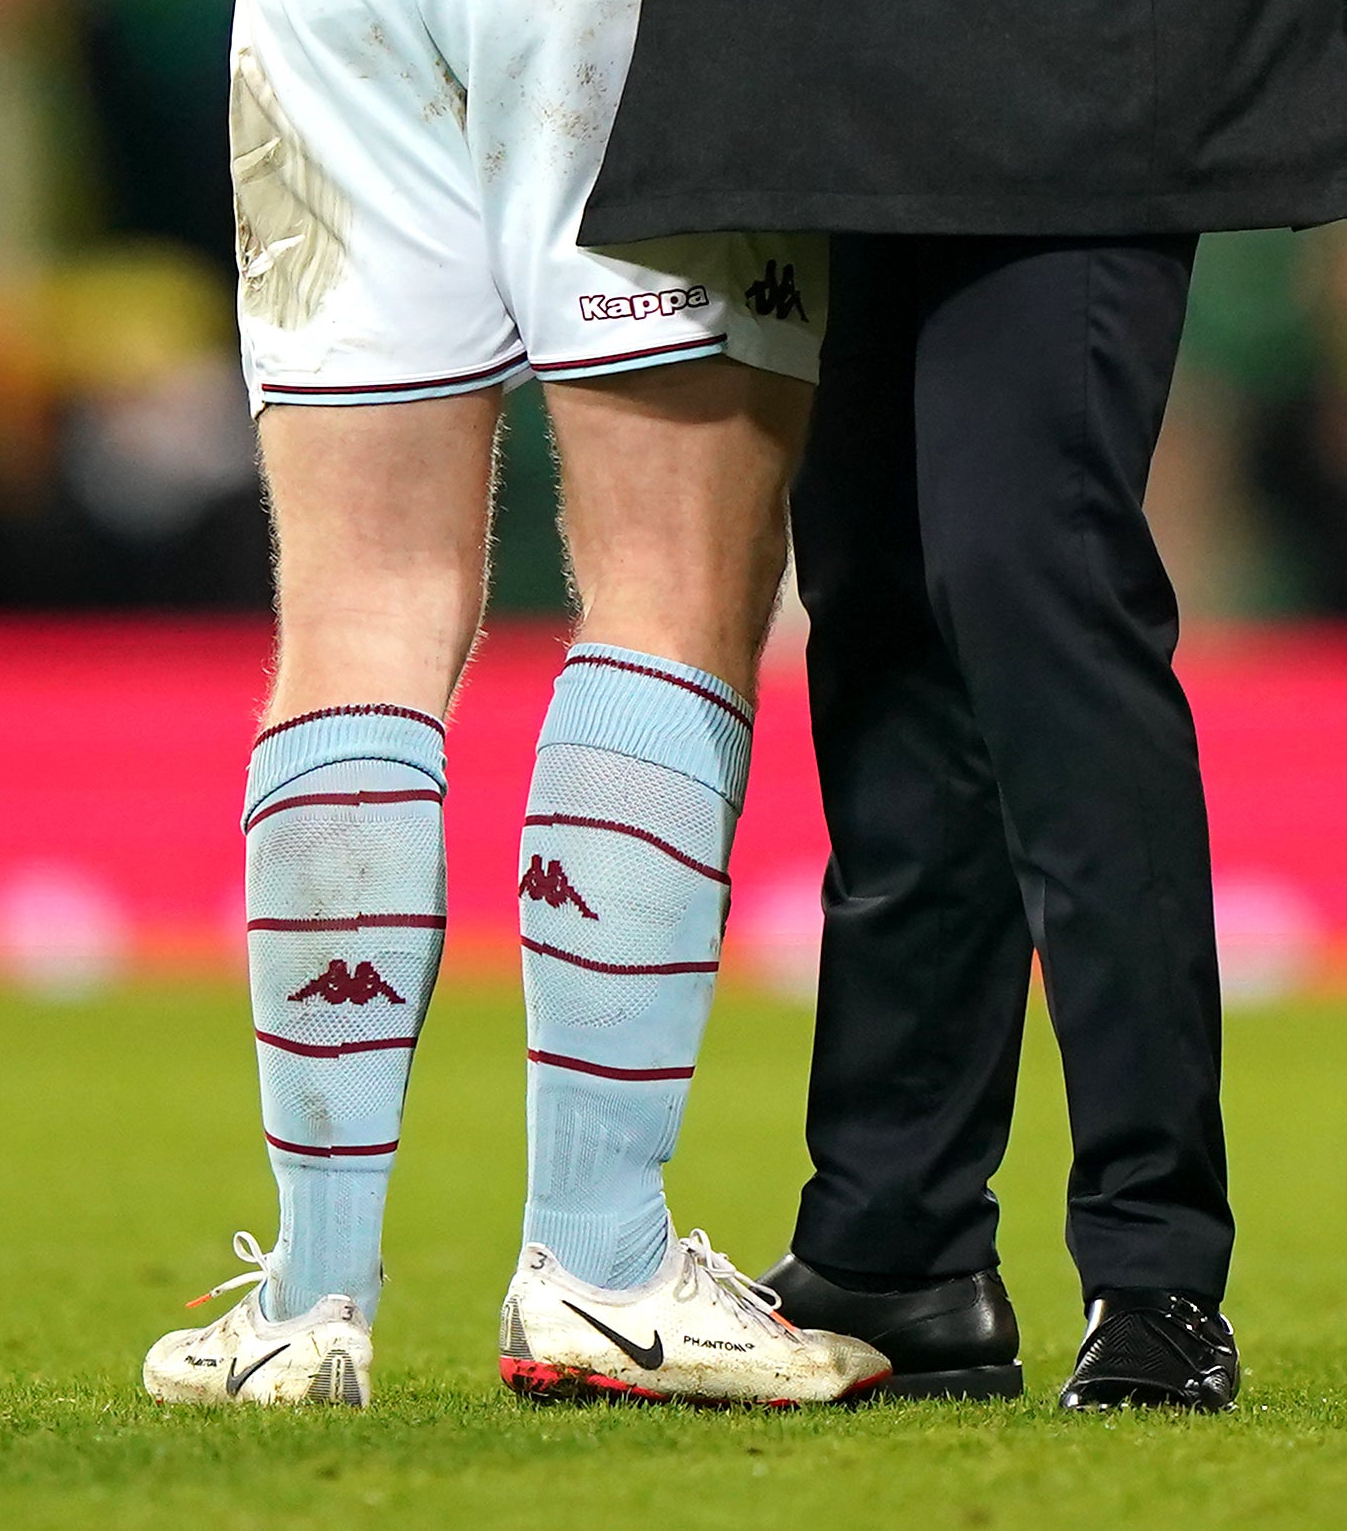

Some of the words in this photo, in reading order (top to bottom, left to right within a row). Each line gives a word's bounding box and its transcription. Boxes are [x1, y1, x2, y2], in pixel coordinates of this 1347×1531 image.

[579, 286, 709, 320] Kappa
[531, 1251, 547, 1270] 3
[342, 1305, 355, 1321] 3
[683, 1335, 746, 1352] PHANTOM
